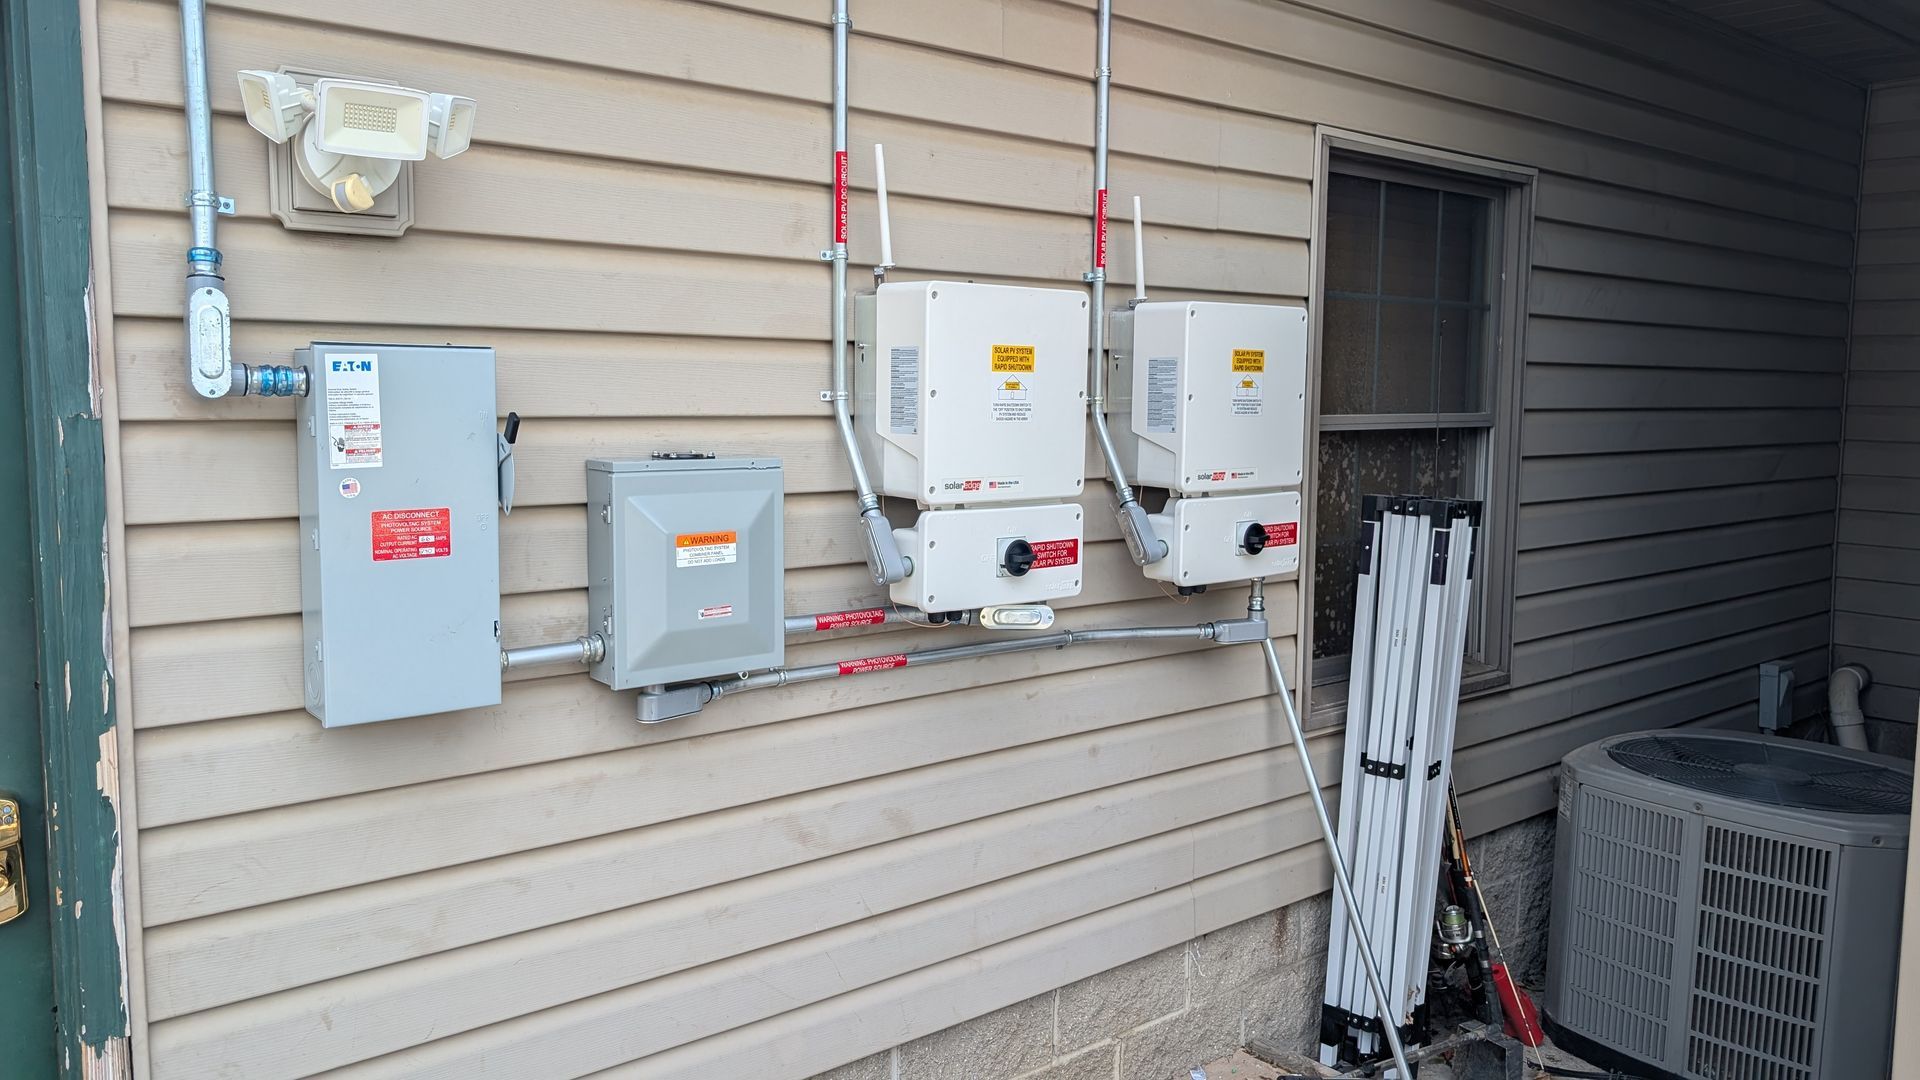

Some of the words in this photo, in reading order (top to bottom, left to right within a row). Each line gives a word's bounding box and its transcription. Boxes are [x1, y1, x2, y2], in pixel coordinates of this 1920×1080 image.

[841, 188, 847, 199] DC
[841, 199, 847, 212] PV
[332, 361, 372, 371] EATON
[945, 480, 981, 491] solaredge
[690, 534, 729, 544] WARNING
[1046, 542, 1074, 550] SHUTDOWN
[1037, 551, 1056, 559] SWITCH
[1055, 557, 1074, 565] SYSTEM
[818, 615, 845, 623] WARNING:
[845, 610, 884, 620] PHOTOVOLTAIC
[867, 655, 906, 664] PHOTOVOLTAIC
